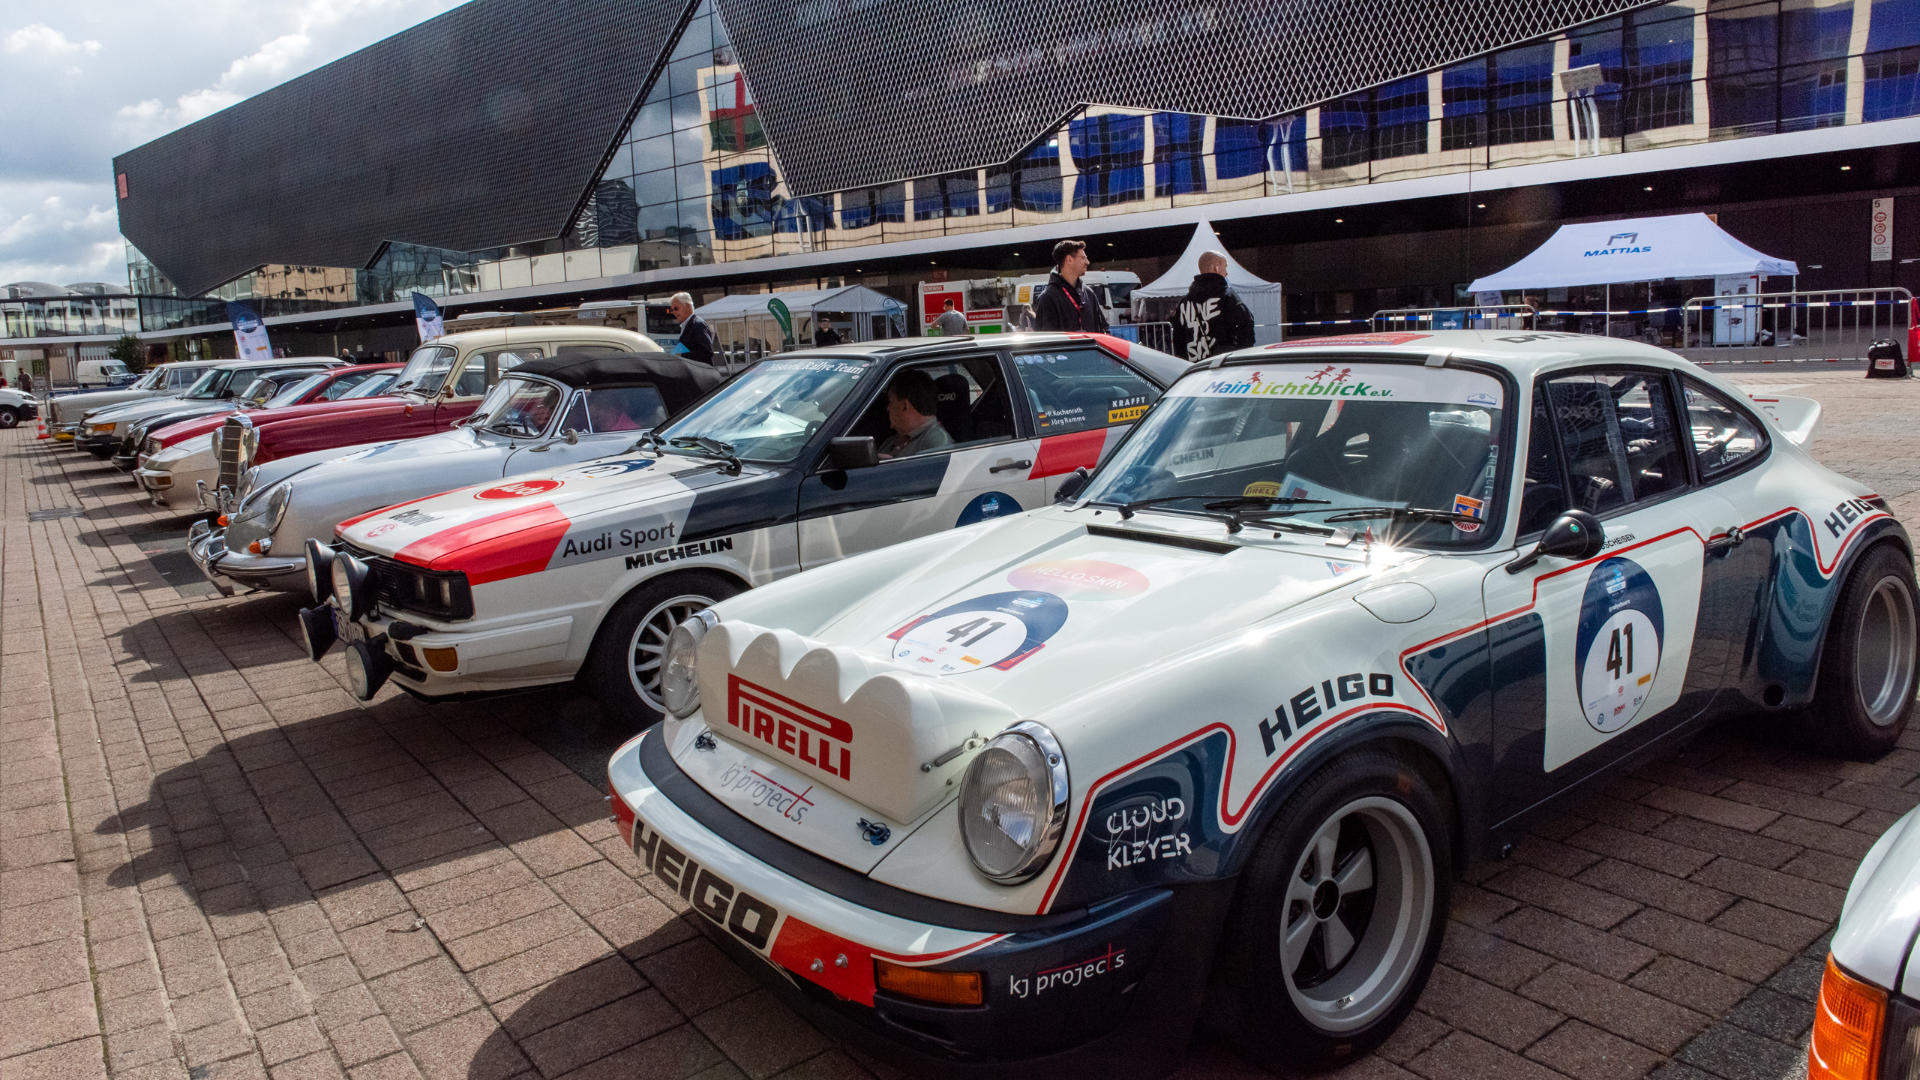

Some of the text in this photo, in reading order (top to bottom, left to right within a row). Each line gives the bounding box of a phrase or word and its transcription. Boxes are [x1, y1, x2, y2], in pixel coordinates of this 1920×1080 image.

[1875, 200, 1881, 208] 5
[1583, 245, 1652, 257] MATTIAS
[833, 362, 865, 375] Team
[1112, 396, 1146, 408] KRAFFT
[562, 521, 676, 559] Audi Sport
[625, 537, 734, 571] MICHELIN
[945, 616, 1007, 648] 41
[1605, 622, 1634, 681] 41
[727, 672, 854, 782] PIRELLI
[1258, 673, 1394, 758] HEIGO
[720, 762, 746, 788] kj
[1106, 797, 1185, 835] CLOUD
[1107, 833, 1192, 871] KLEYER
[633, 817, 779, 950] HEIGO
[1009, 943, 1126, 998] kj projects
